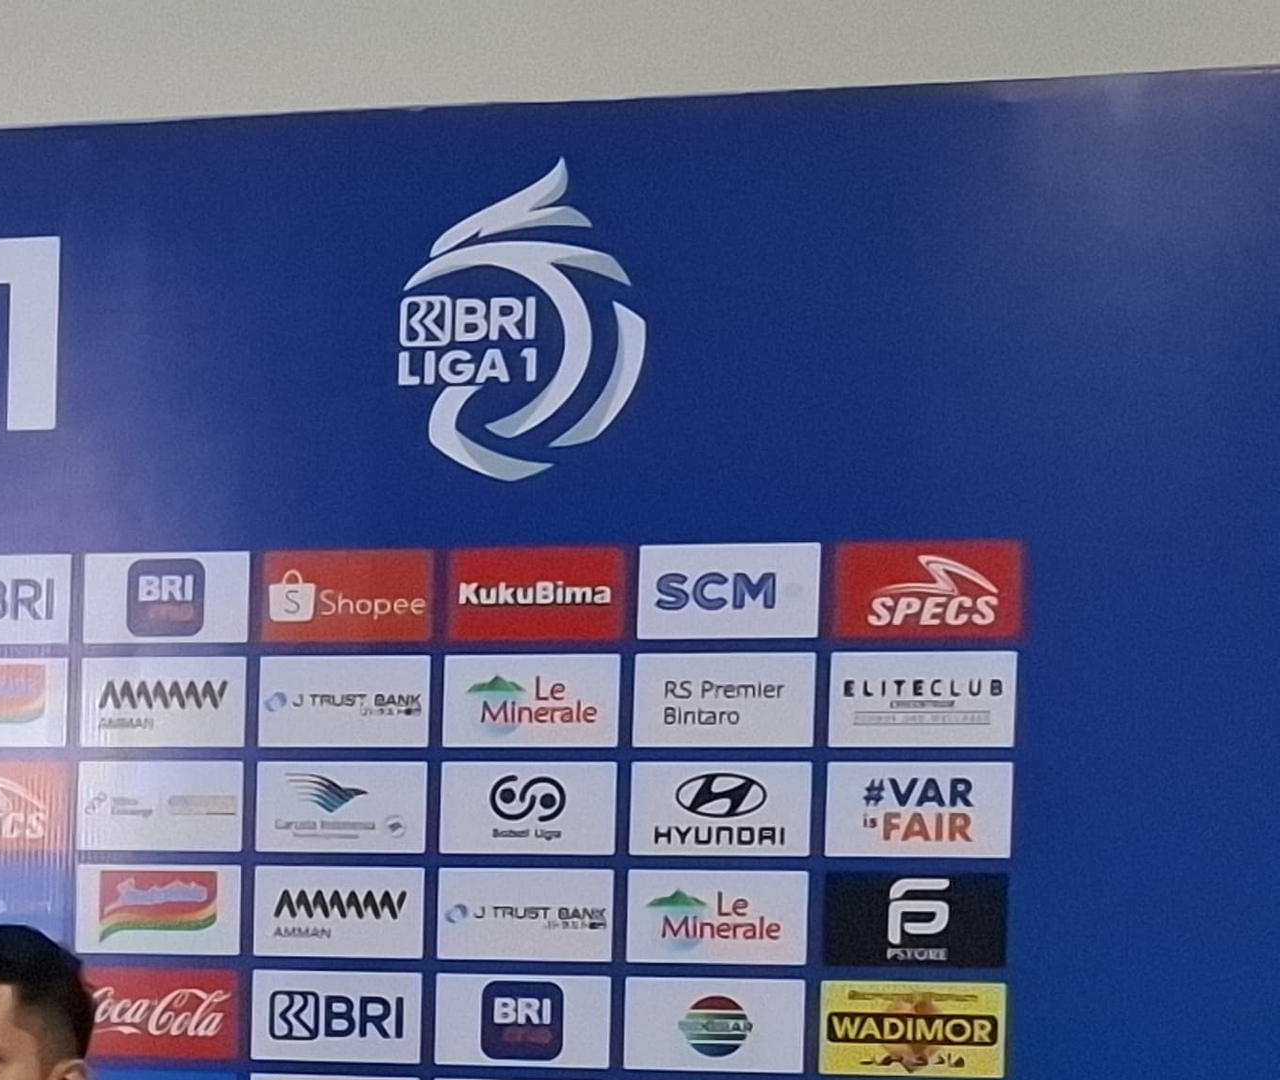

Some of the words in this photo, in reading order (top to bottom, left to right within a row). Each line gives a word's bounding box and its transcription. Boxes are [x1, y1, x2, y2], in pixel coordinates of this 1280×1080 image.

[455, 297, 536, 342] BRI
[398, 349, 509, 385] LIGA
[520, 348, 537, 382] 1
[139, 575, 193, 601] BRI
[459, 582, 611, 605] KukuBima
[656, 572, 775, 610] SCM
[321, 590, 425, 620] Shopee
[867, 597, 998, 626] SPECS
[293, 695, 302, 707] J
[307, 693, 367, 707] TRUST
[374, 693, 421, 707] BANK
[536, 676, 565, 701] Le
[664, 681, 692, 698] RS
[701, 681, 784, 700] Premier
[480, 702, 597, 724] Minerale
[664, 708, 739, 725] Bintaro
[864, 777, 973, 807] #VAR
[654, 826, 785, 845] HYUNDAI
[864, 815, 877, 829] is
[883, 813, 972, 842] FAIR
[473, 907, 486, 919] J
[491, 906, 552, 920] TRUST
[558, 906, 606, 921] BANK
[717, 891, 748, 916] Le
[661, 916, 781, 940] Minerale
[324, 996, 404, 1039] BRI
[493, 998, 551, 1025] BRI
[831, 1017, 991, 1041] WADIMOR
